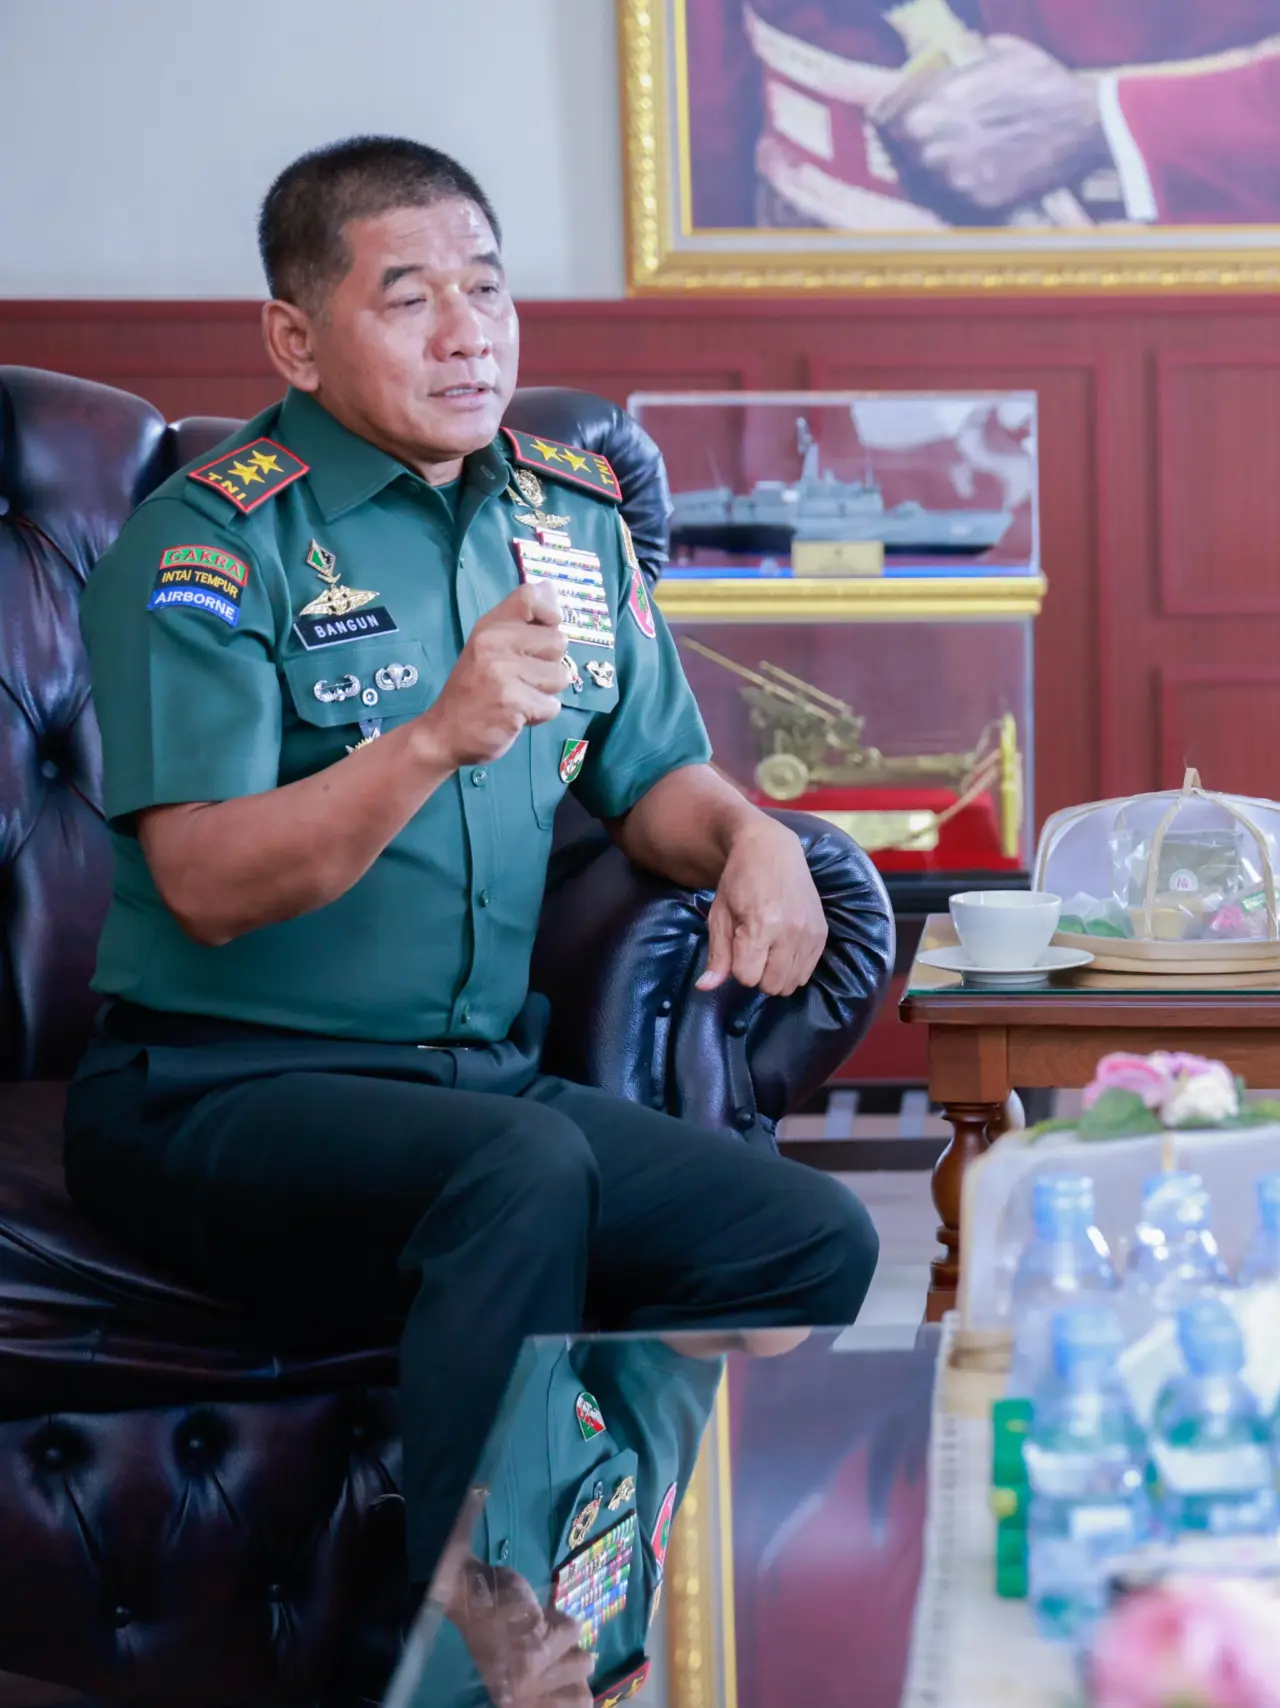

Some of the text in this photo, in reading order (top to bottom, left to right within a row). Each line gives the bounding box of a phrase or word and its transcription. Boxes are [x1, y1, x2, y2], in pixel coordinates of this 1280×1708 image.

[207, 471, 247, 500] TNI
[169, 548, 242, 578] CAKRA
[161, 569, 239, 599] INTAI TEMPUR
[154, 591, 236, 621] AIRBORNE
[313, 614, 380, 639] BANGUN
